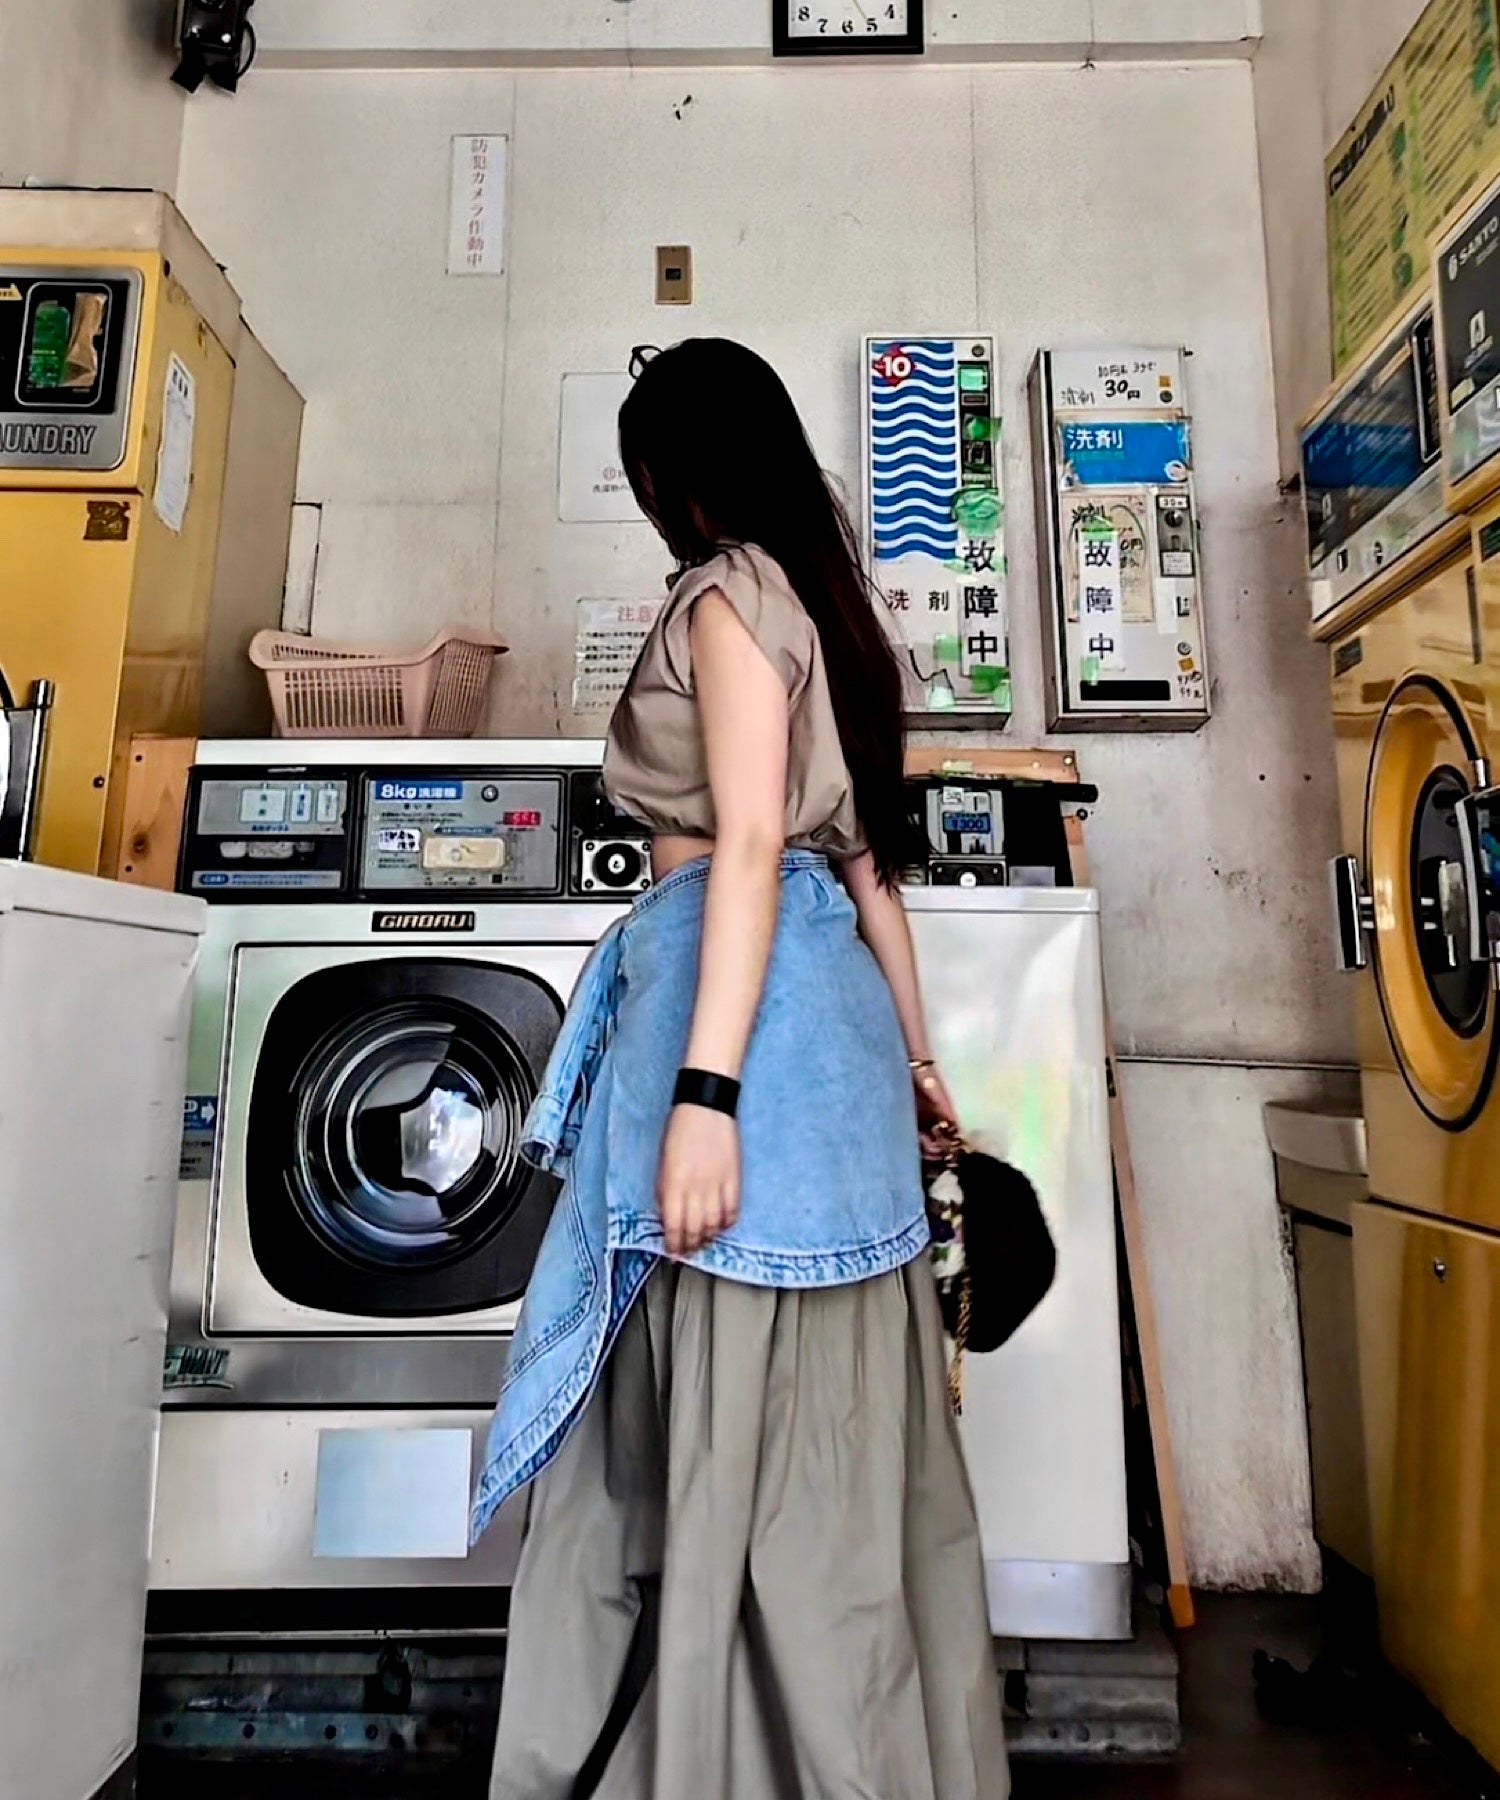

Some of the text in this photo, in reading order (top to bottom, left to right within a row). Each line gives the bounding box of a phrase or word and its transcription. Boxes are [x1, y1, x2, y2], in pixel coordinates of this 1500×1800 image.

[798, 6, 810, 21] 8
[866, 17, 878, 32] 5
[817, 18, 828, 33] 7
[842, 20, 854, 33] 6
[882, 356, 912, 378] 10
[0, 421, 97, 458] UNDRY
[1066, 427, 1123, 450] 洗剤
[963, 540, 998, 663] 故障中
[1085, 540, 1114, 661] 故障中
